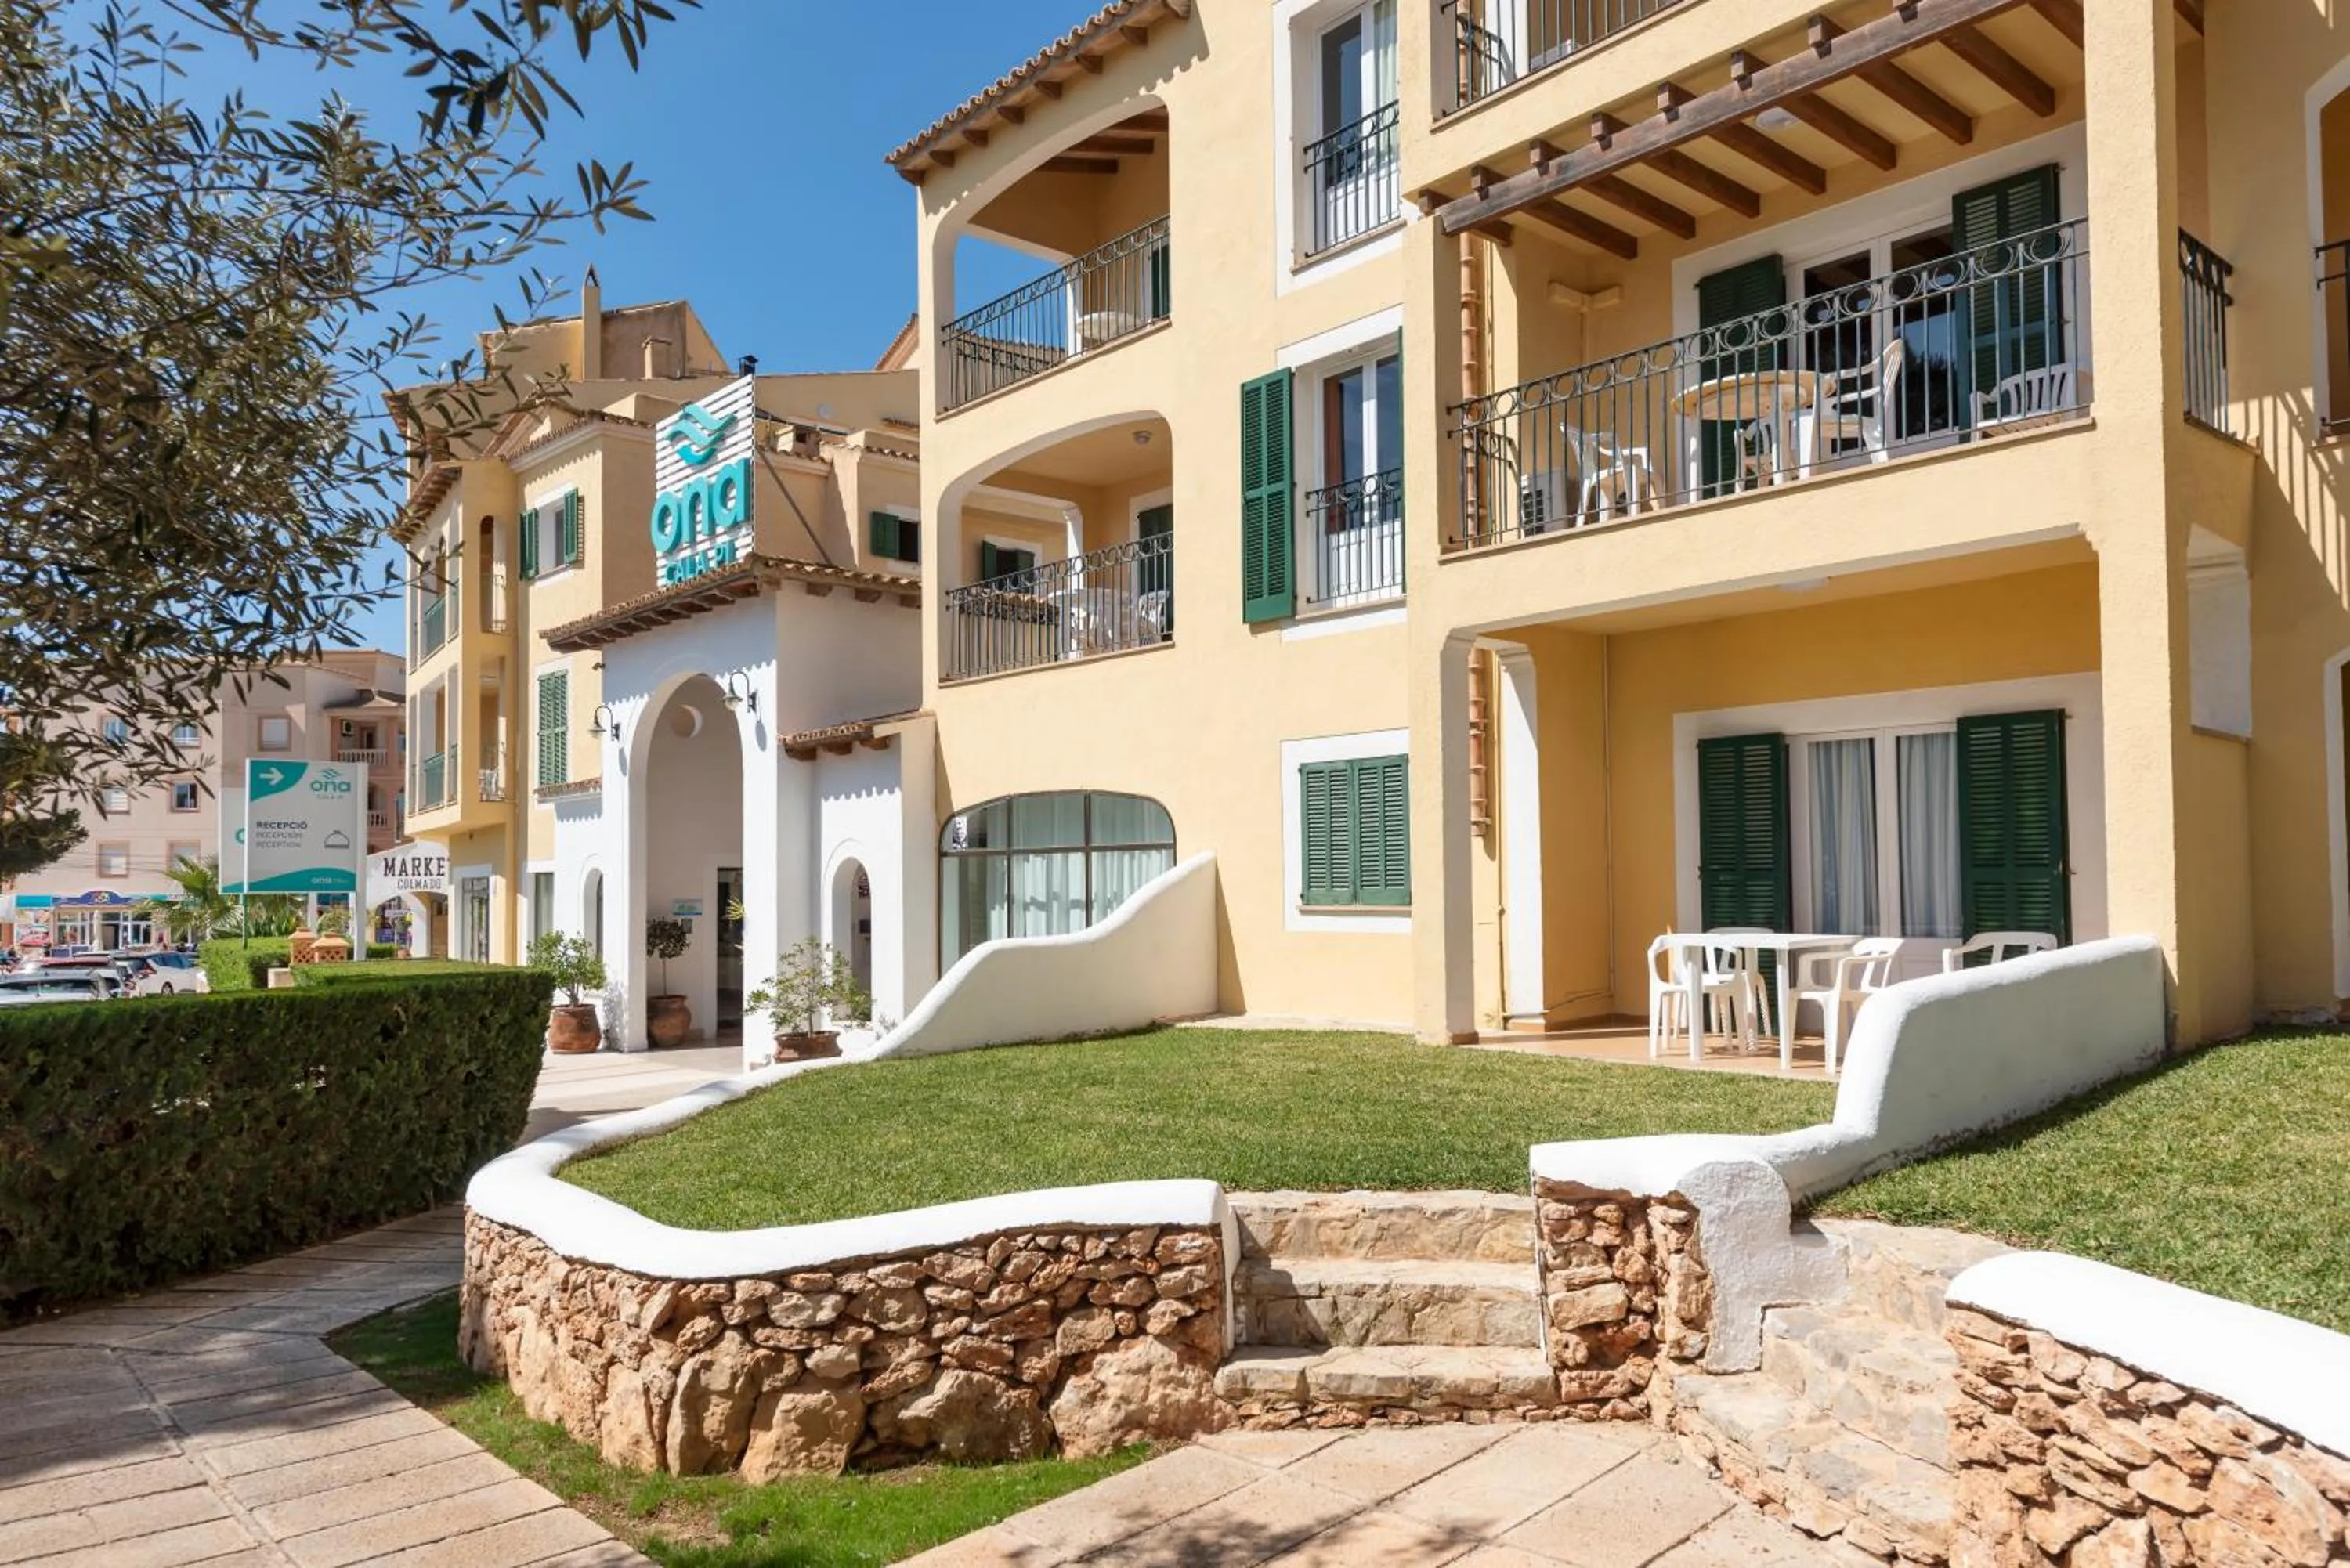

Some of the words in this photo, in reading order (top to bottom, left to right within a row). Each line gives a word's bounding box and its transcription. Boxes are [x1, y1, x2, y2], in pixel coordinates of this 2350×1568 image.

[651, 457, 752, 552] ona
[666, 551, 710, 584] CALA
[311, 780, 351, 792] ona
[384, 857, 450, 876] MARKE
[398, 879, 441, 890] COLMADO
